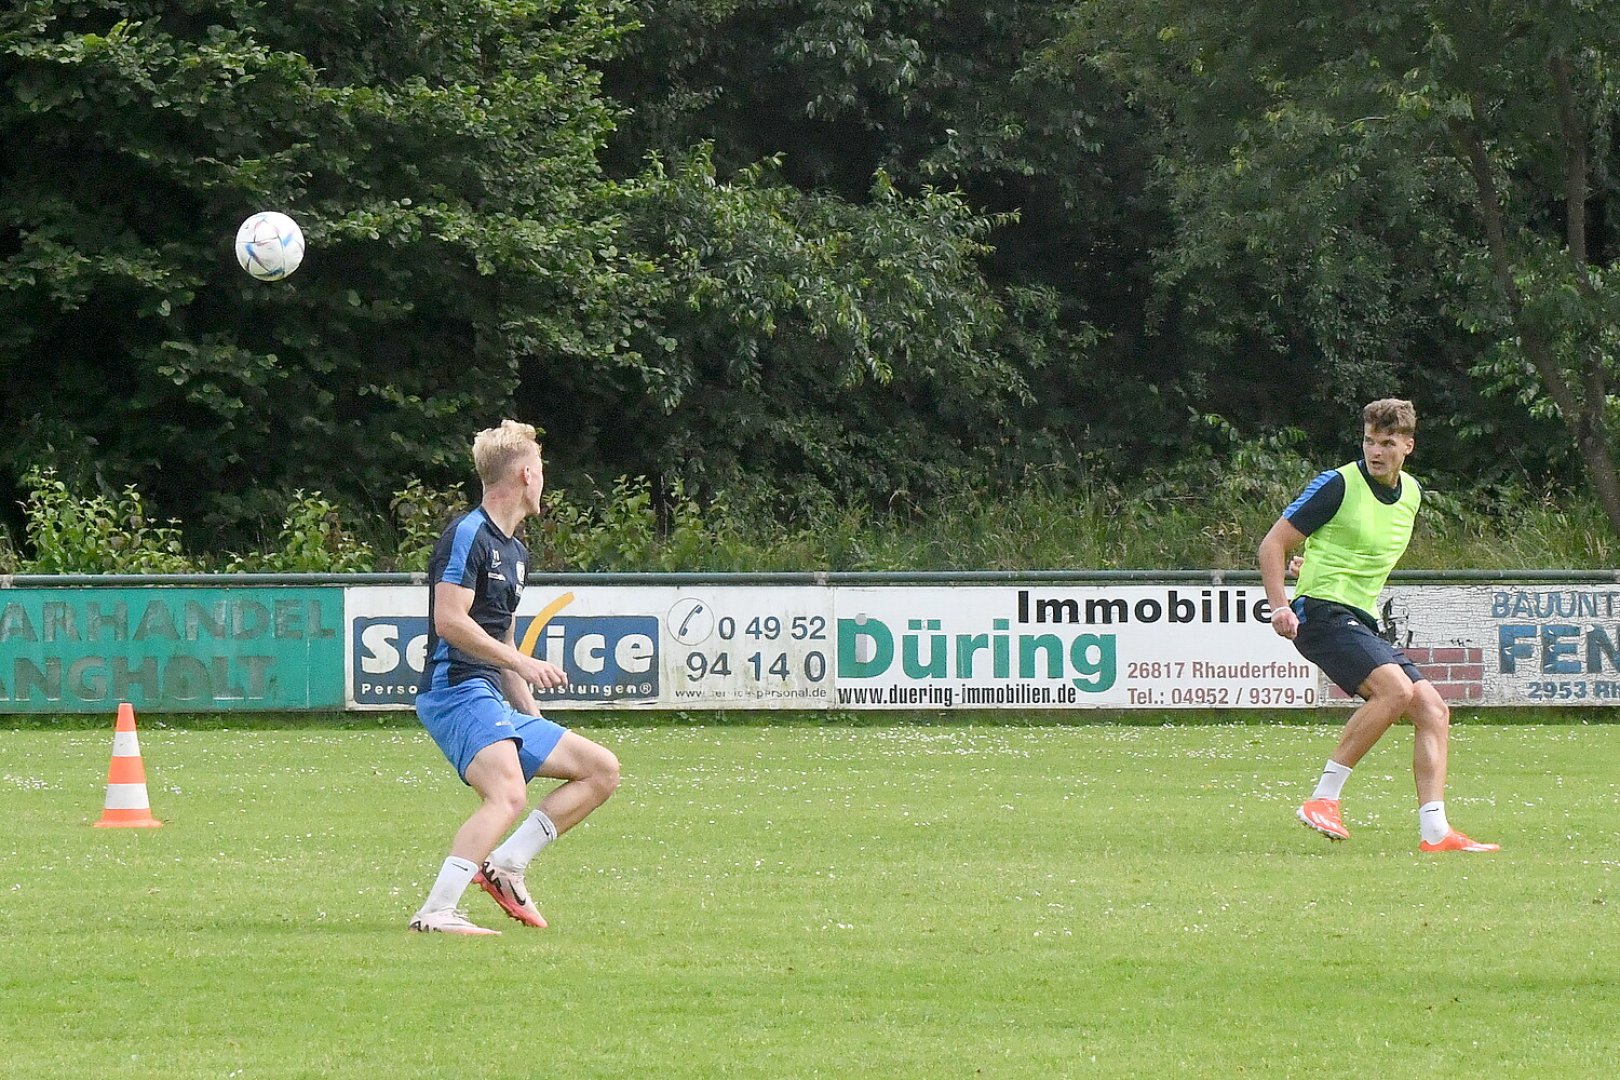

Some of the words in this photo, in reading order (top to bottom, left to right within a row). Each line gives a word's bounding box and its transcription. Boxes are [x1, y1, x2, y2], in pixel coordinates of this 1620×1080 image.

[0, 600, 336, 642] ARHANDEL
[1018, 590, 1271, 624] Immobilie
[361, 592, 654, 674] Sevice
[718, 616, 735, 641] 0
[745, 616, 781, 641] 49
[791, 616, 826, 641] 52
[686, 651, 732, 682] 94
[747, 652, 790, 682] 14
[804, 651, 826, 683] 0
[837, 618, 1117, 693] Düring
[1127, 662, 1185, 679] 26817
[1192, 661, 1310, 679] Rhauderfehn
[0, 655, 276, 701] NGHOLT
[1528, 682, 1587, 698] 2953
[838, 683, 1076, 706] www.duering-immobilien.de
[1127, 688, 1164, 704] Tel.:
[1171, 688, 1229, 704] 04952
[1250, 688, 1315, 704] 9379-0
